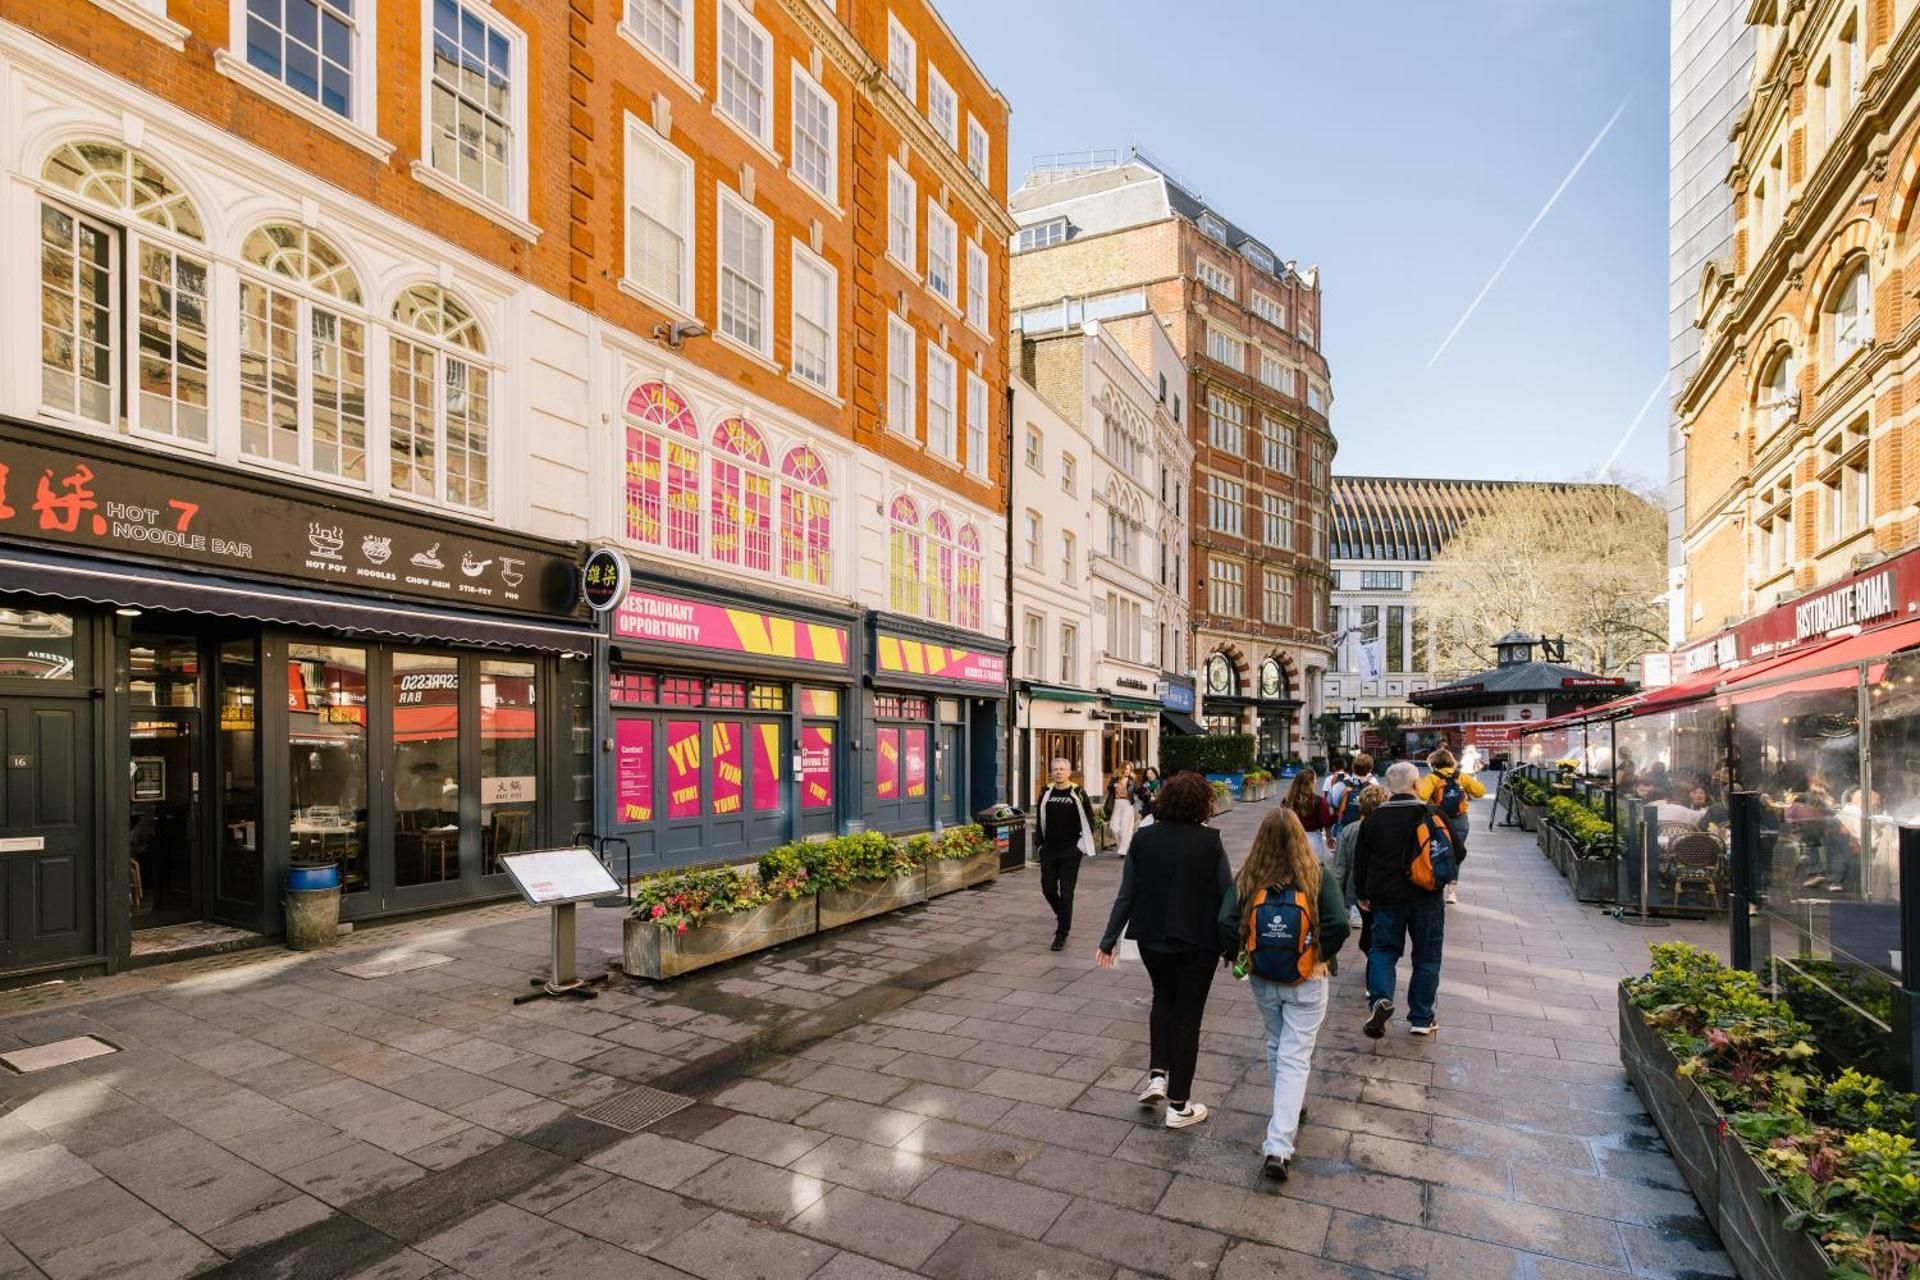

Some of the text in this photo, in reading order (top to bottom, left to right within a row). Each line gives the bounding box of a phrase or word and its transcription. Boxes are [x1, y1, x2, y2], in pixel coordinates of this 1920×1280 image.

[106, 499, 199, 532] HOT 7
[113, 522, 253, 559] NOODLE BAR
[305, 560, 347, 573] HOT POT
[357, 568, 397, 581] NOODLES
[405, 576, 450, 589] CHOW MEIN
[459, 584, 492, 596] STIR-FRY
[505, 591, 519, 600] PHO
[1796, 571, 1891, 641] RISTORANTE ROMA
[620, 615, 700, 641] OPPORTUNITY
[621, 746, 643, 754] Contact
[14, 758, 26, 767] 16
[713, 794, 740, 813] YUM!
